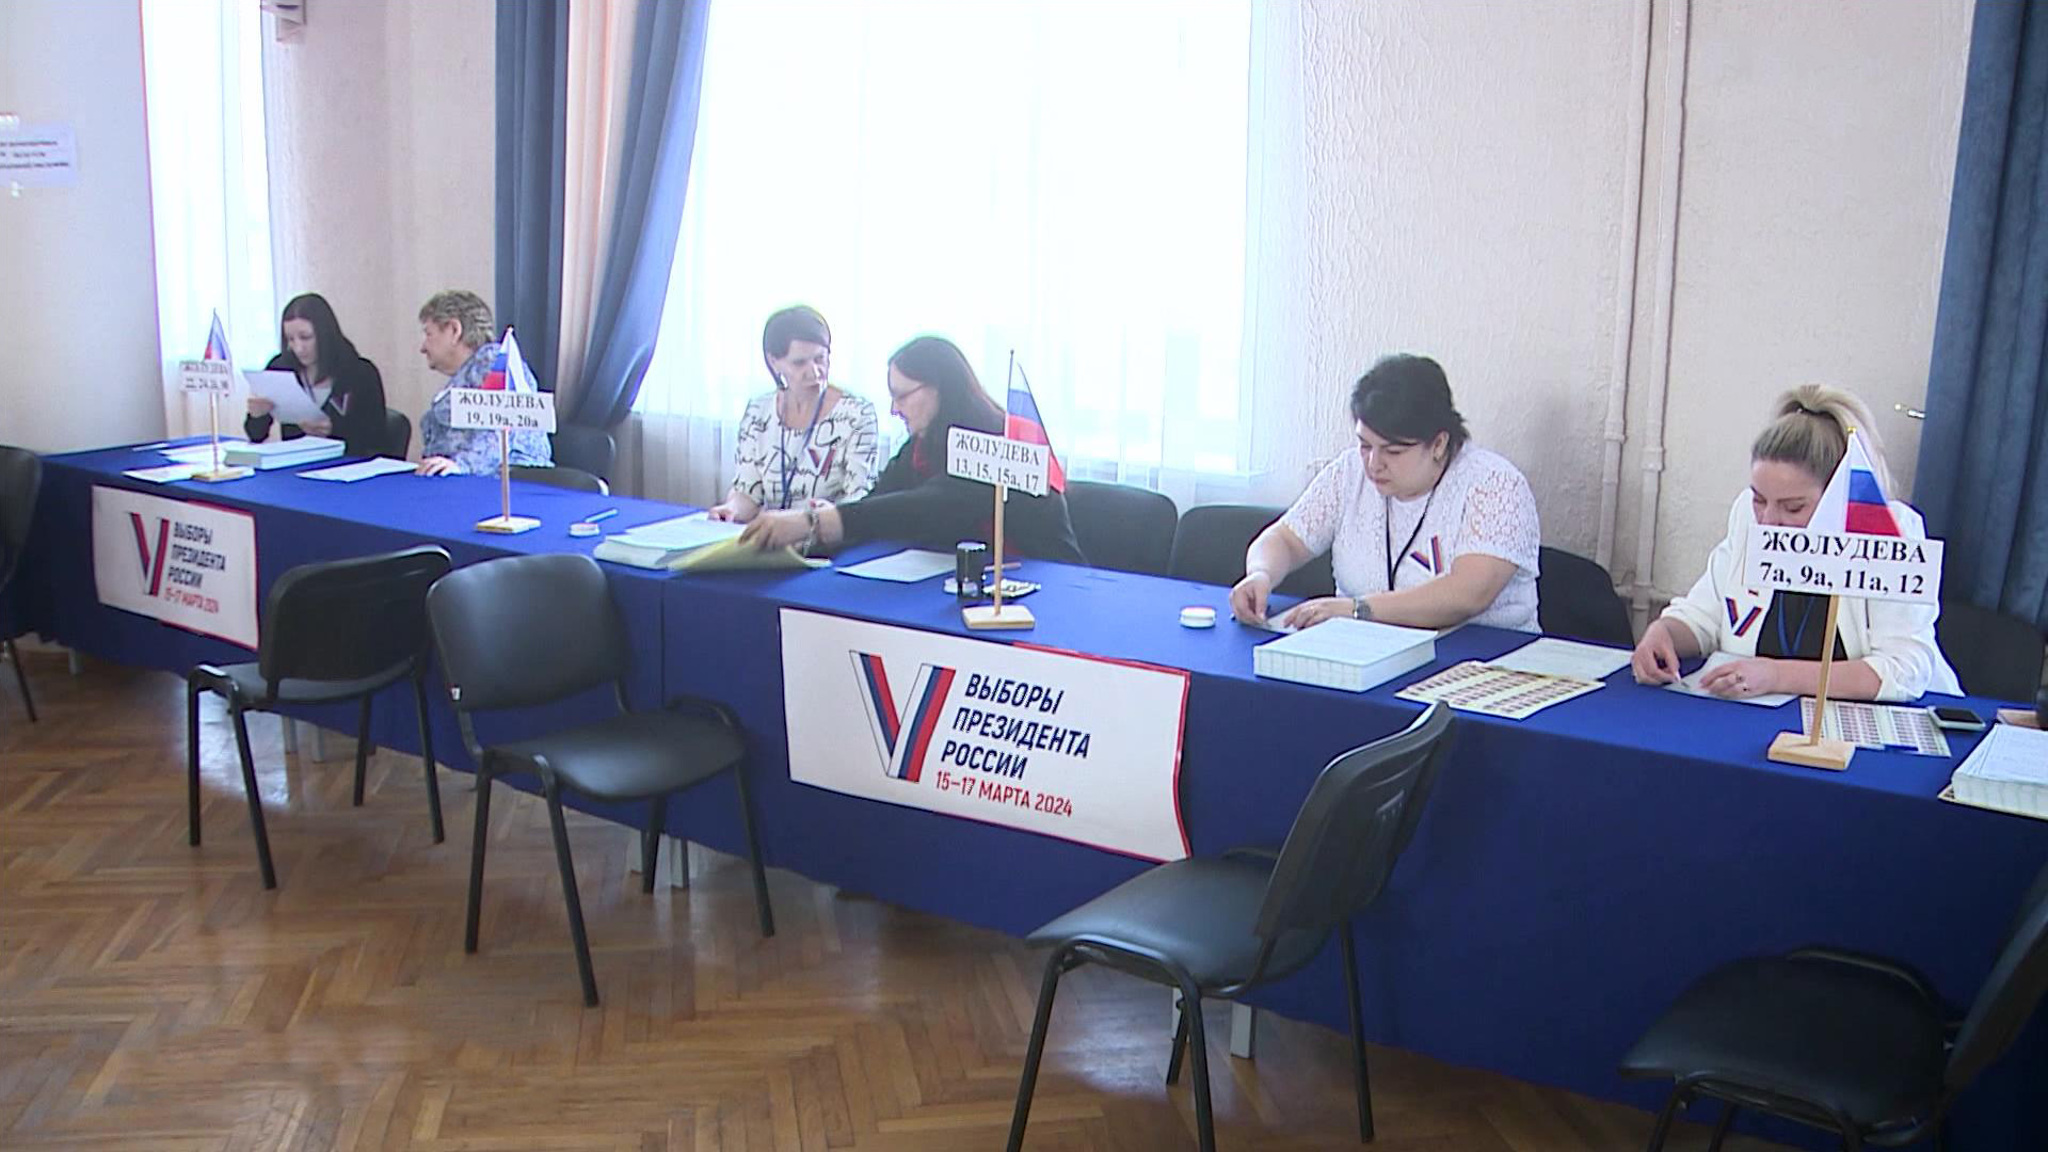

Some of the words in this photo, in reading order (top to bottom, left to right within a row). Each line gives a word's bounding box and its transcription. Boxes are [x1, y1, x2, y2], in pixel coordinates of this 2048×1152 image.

[458, 391, 545, 409] ЖОЛУДЕВА
[467, 411, 484, 425] 19,
[489, 412, 513, 427] 19а,
[517, 414, 538, 428] 20а
[955, 432, 1039, 466] ЖОЛУДЕВА
[956, 458, 972, 475] 13,
[976, 462, 992, 480] 15,
[998, 467, 1020, 487] 15а,
[1026, 474, 1039, 490] 17
[173, 521, 213, 545] ВЫБОРЫ
[1762, 531, 1926, 564] ЖОЛУДЕВА
[171, 543, 226, 571] ПРЕЗИДЕНТА
[168, 566, 204, 588] РОССИИ
[1760, 562, 1792, 586] 7а,
[1801, 565, 1833, 589] 9а,
[1844, 569, 1889, 592] 11а,
[1900, 575, 1924, 594] 12
[965, 673, 1064, 714] ВЫБОРЫ
[952, 707, 1091, 759] ПРЕЗИДЕНТА
[941, 740, 1028, 781] РОССИИ
[978, 780, 1031, 810] МАРТА
[1035, 793, 1073, 817] 2024
